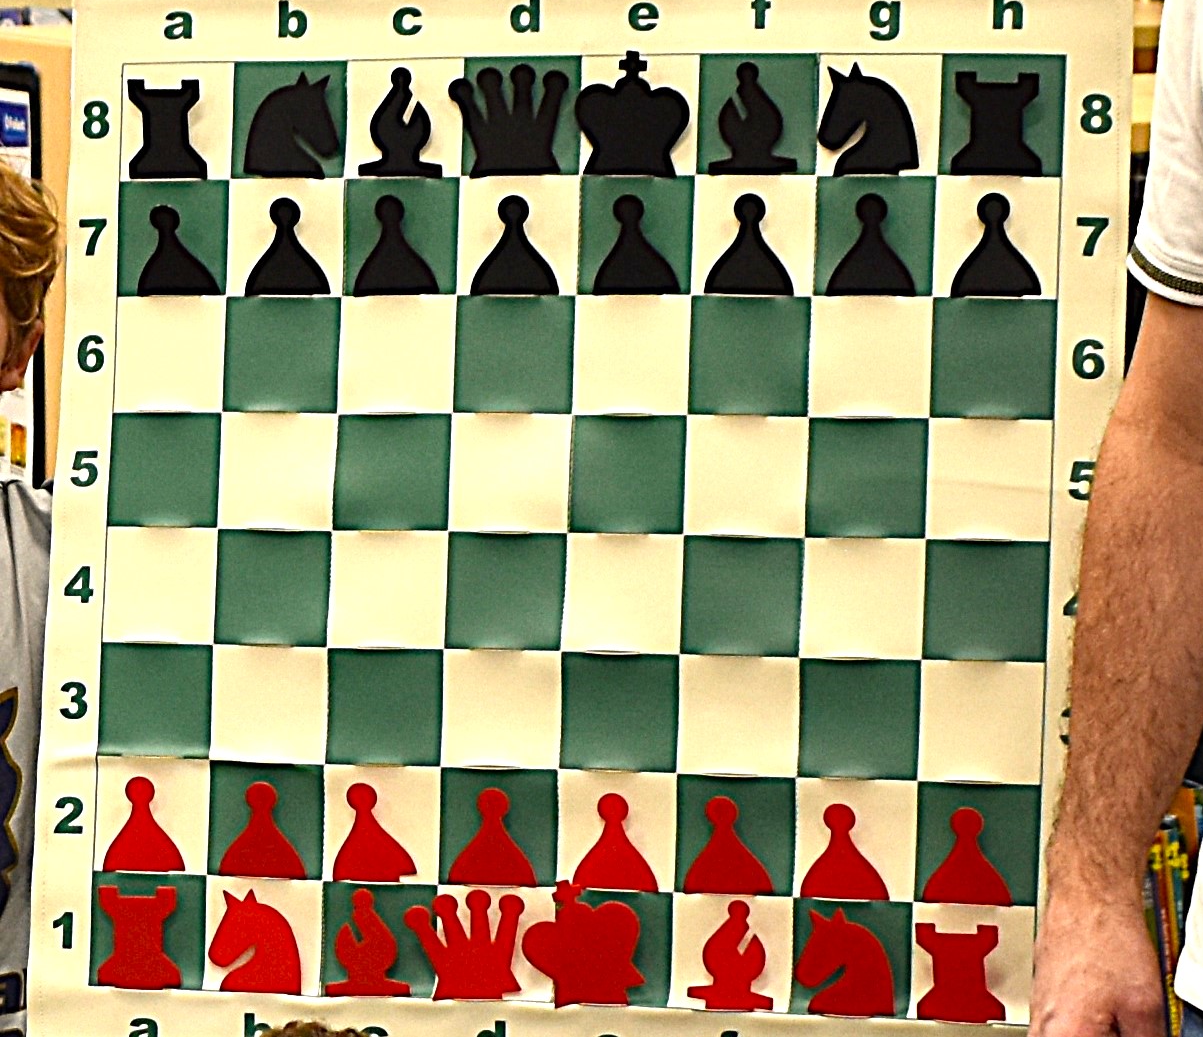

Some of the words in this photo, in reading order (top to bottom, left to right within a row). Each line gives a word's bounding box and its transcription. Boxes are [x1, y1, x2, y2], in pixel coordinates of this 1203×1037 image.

[163, 11, 193, 40] a
[278, 0, 308, 39] b
[392, 7, 422, 36] c
[628, 2, 659, 32] e
[869, 0, 901, 41] g
[82, 100, 110, 140] 8
[1080, 93, 1113, 135] 8
[78, 218, 108, 256] 7
[1076, 216, 1109, 257] 7
[77, 334, 105, 373] 6
[1072, 339, 1105, 380] 6
[70, 450, 98, 488] 5
[1068, 461, 1095, 502] 5
[63, 565, 94, 604] 4
[59, 681, 88, 720] 3
[53, 796, 84, 835] 2
[52, 911, 74, 950] 1
